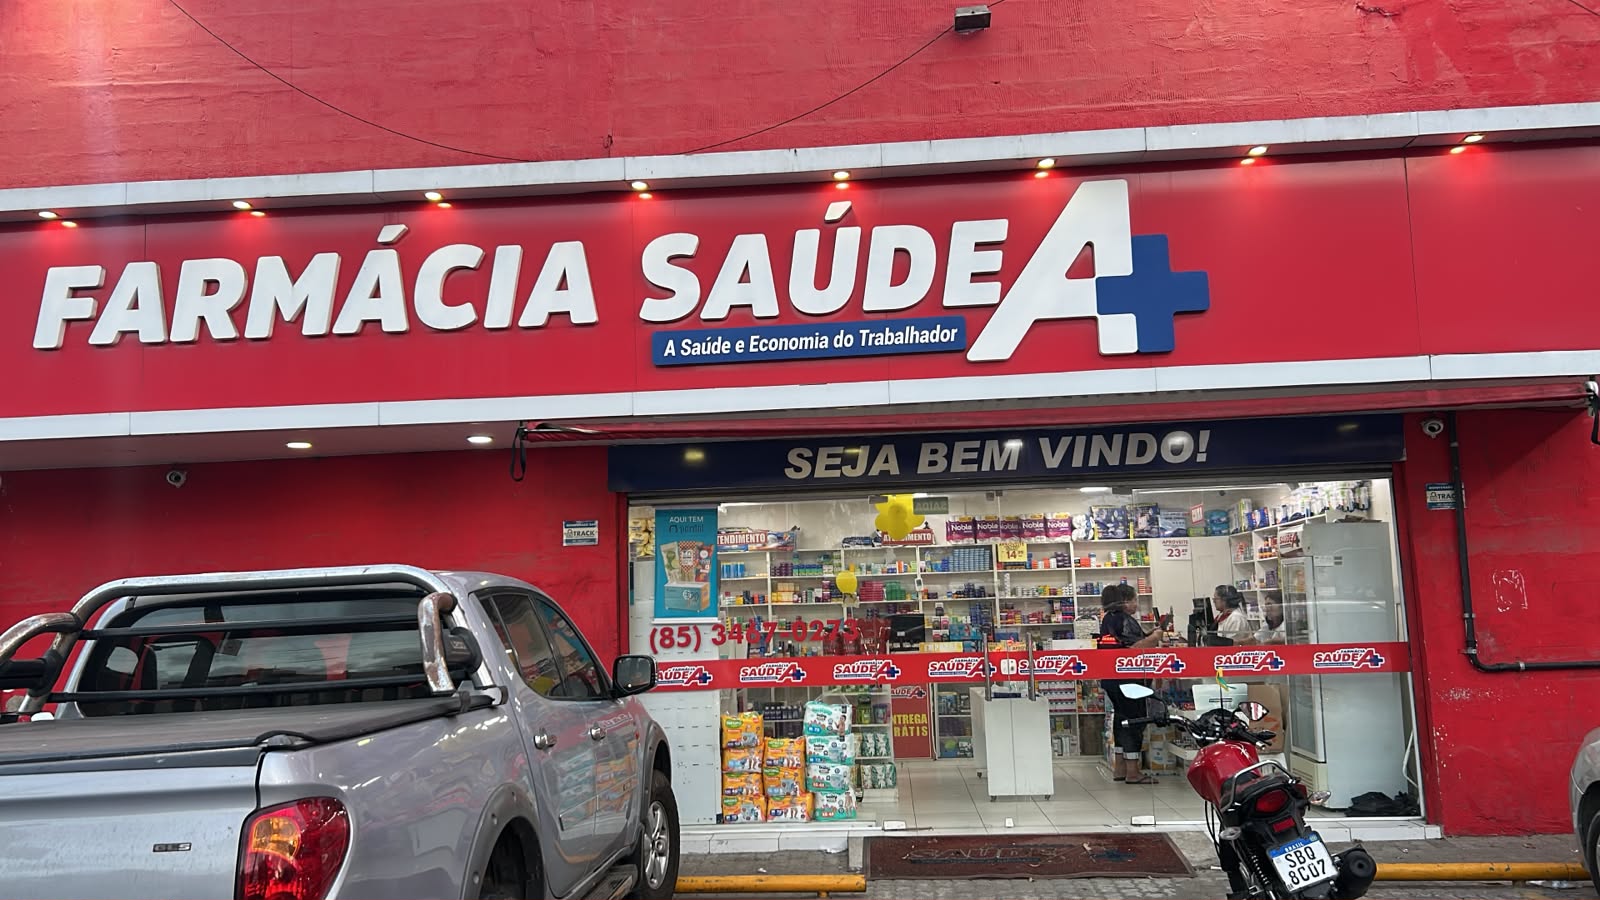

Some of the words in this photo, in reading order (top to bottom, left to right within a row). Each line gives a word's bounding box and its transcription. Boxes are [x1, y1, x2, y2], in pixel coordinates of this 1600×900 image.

[33, 224, 598, 349] FARMÁCIA
[639, 201, 1009, 322] SAÚDE
[664, 340, 676, 357] A
[680, 336, 731, 356] Saúde
[735, 340, 745, 353] e
[749, 331, 829, 352] Economia
[833, 329, 852, 348] do
[859, 325, 958, 347] Trabalhador
[784, 444, 900, 479] SEJA
[916, 438, 1023, 475] BEM
[1039, 430, 1211, 469] VINDO!
[717, 532, 766, 545] TENDIMENTO
[1167, 548, 1181, 558] 23
[650, 625, 701, 654] (85)
[711, 618, 859, 646] 3467-0273
[1216, 653, 1258, 665] SAÚDE
[1315, 651, 1359, 662] SAÚDE
[658, 669, 689, 680] AÚDE
[741, 666, 782, 677] SAÚDE
[894, 724, 928, 736] RÁTIS
[1285, 846, 1316, 868] SBQ
